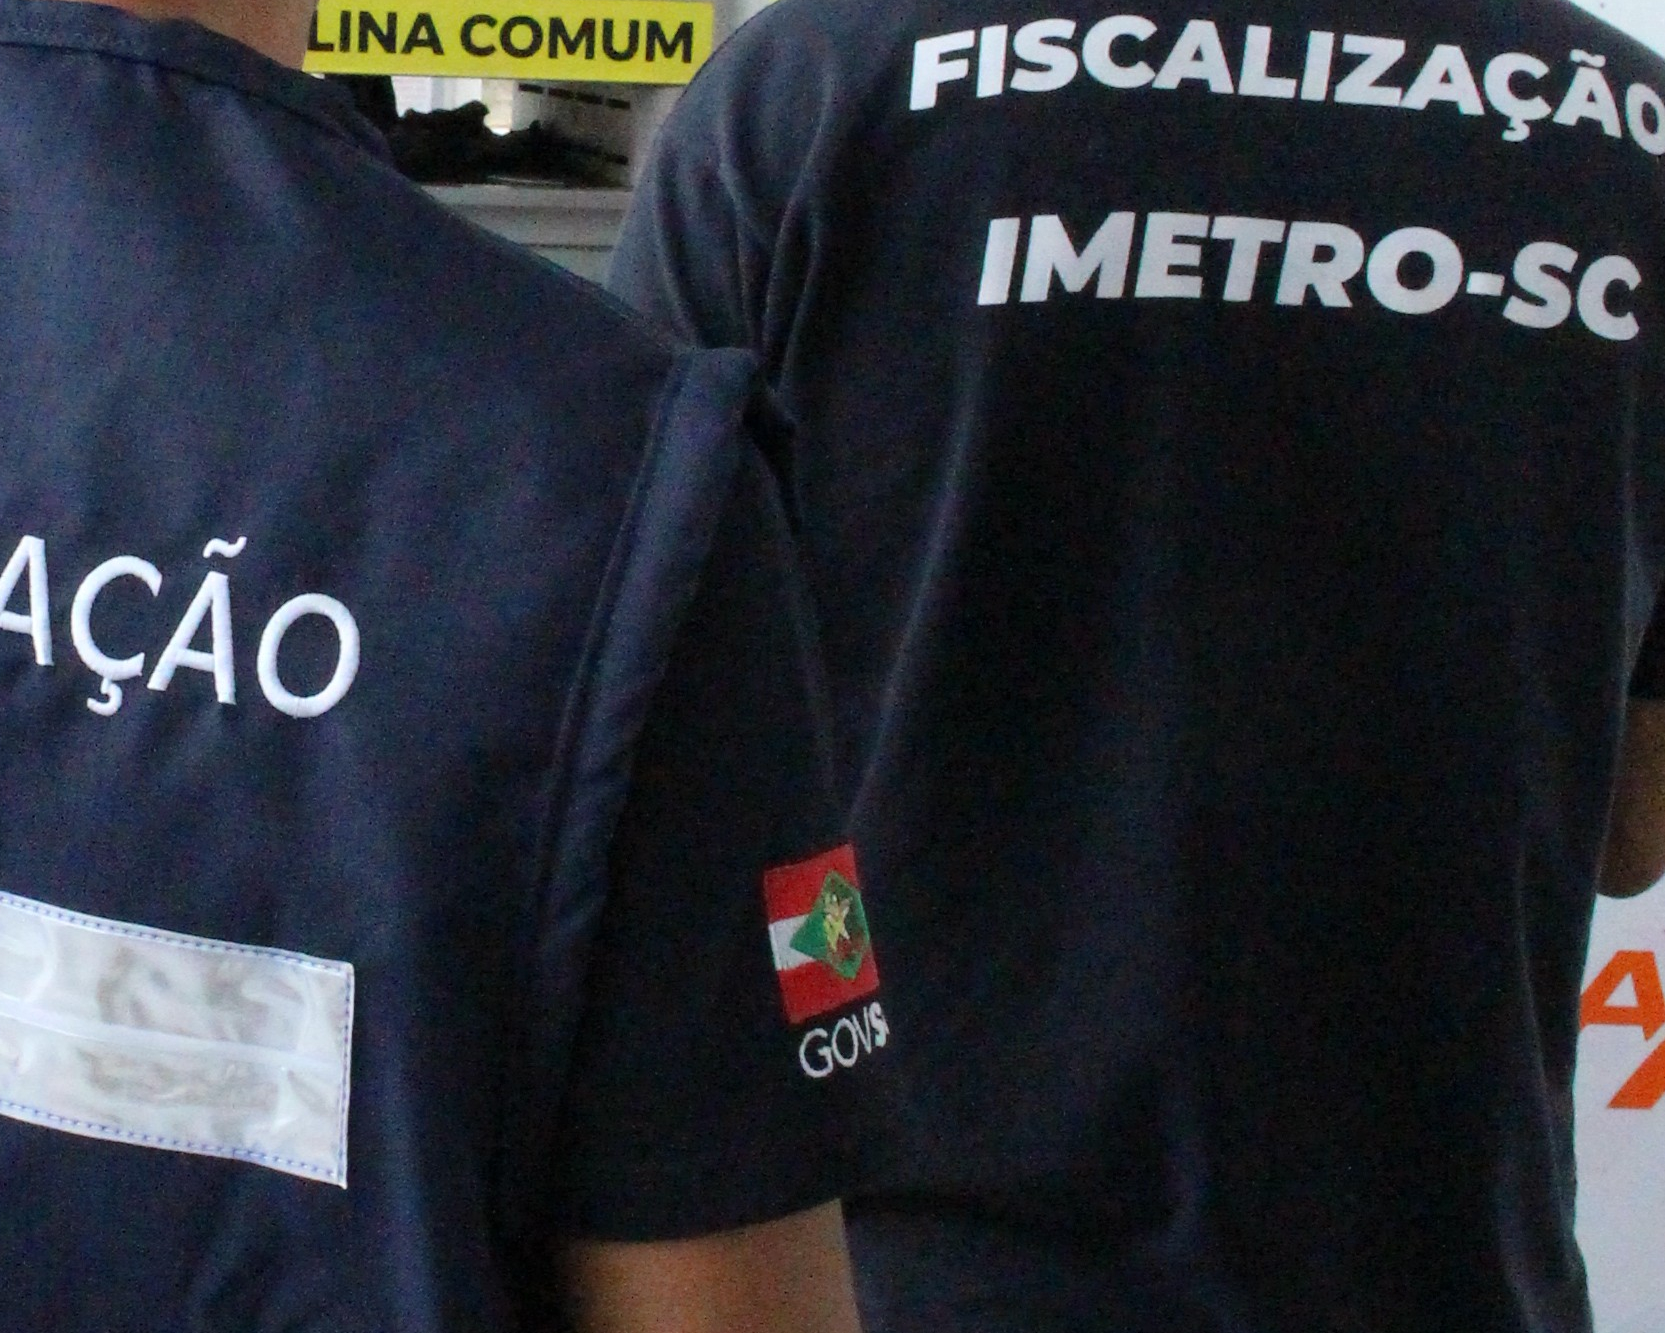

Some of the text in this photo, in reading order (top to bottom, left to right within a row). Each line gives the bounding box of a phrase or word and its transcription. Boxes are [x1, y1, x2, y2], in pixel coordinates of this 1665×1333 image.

[307, 10, 694, 64] LINA COMUM
[909, 14, 1665, 157] FISCALIZAÇÃO
[976, 210, 1643, 342] IMETRO-SC
